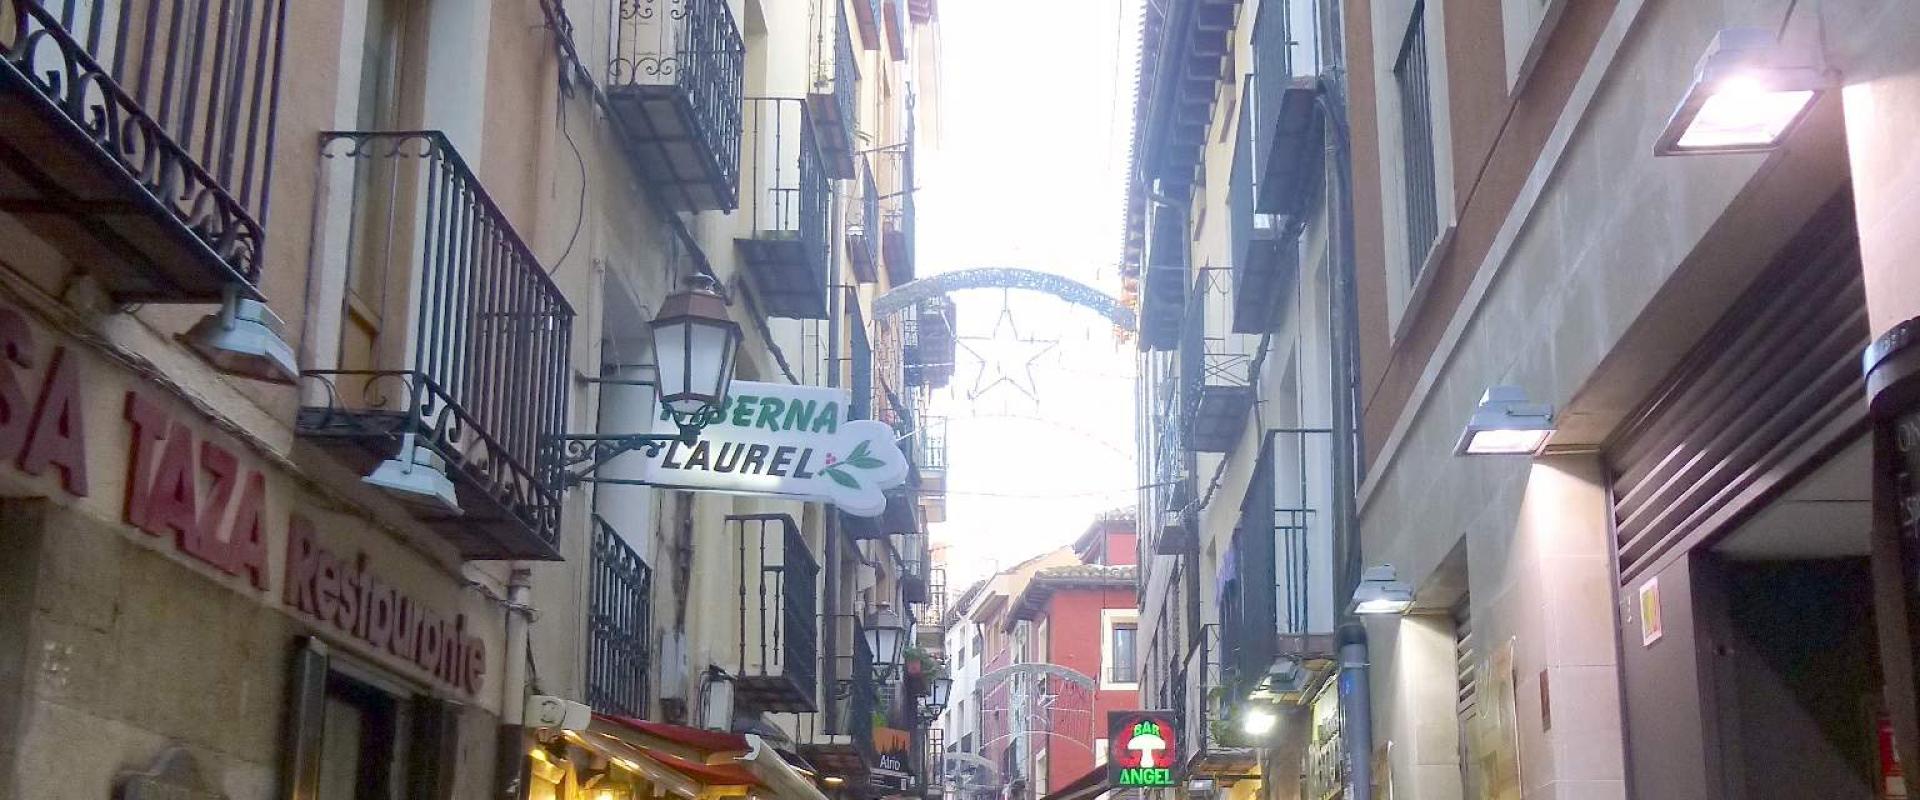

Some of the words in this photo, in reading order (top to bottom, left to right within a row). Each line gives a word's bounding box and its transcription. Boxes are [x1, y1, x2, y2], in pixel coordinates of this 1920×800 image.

[659, 393, 839, 434] BERNA
[661, 439, 815, 479] LAUREL
[122, 391, 270, 592] TAZA
[283, 513, 486, 695] Restaurante
[1133, 721, 1160, 736] BAR
[1120, 768, 1175, 785] ANGEL
